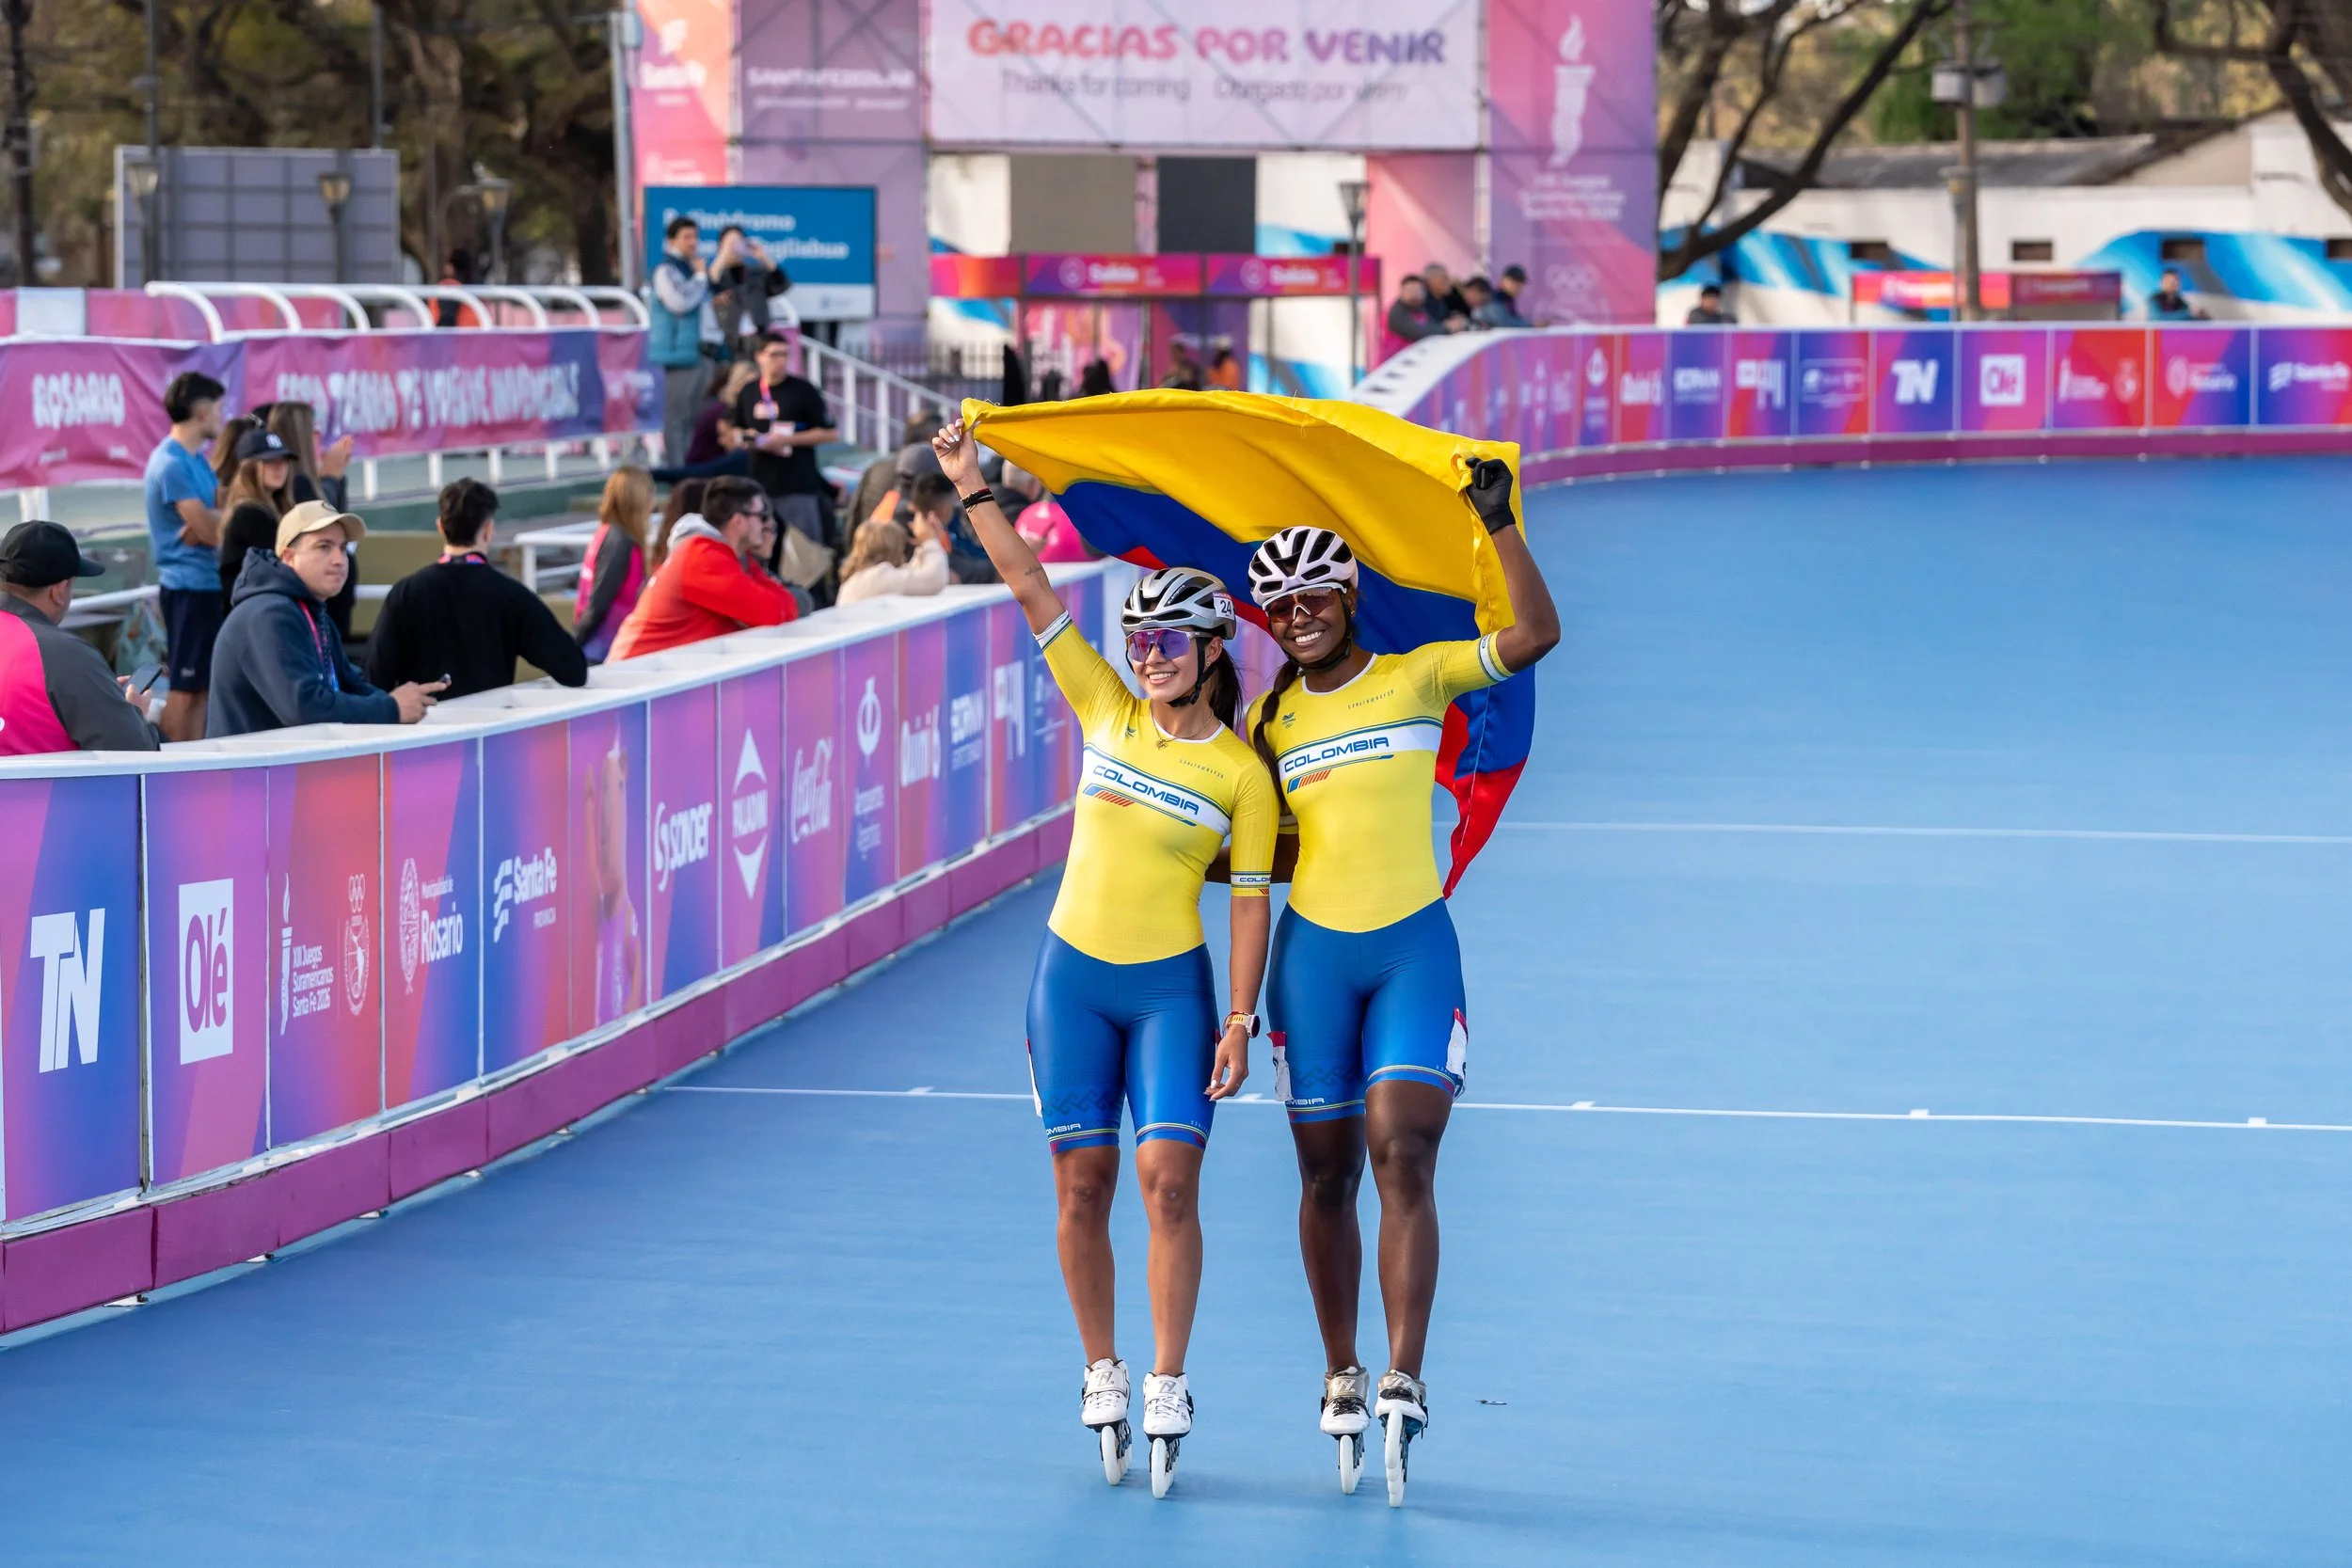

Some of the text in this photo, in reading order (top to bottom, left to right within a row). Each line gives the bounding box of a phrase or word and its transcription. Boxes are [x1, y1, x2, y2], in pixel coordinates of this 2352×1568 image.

[967, 18, 1445, 66] GRACIAS POR VENIR
[32, 372, 126, 431] ROSARIO
[1891, 358, 1939, 405] TN
[1220, 599, 1232, 615] 24
[1284, 736, 1390, 773] COLOMBIA
[1093, 765, 1200, 816] COLOMBIA
[514, 846, 558, 905] Santa Fe
[421, 900, 464, 964] Rosario
[30, 908, 105, 1073] TN
[186, 907, 229, 1033] Olé
[293, 995, 310, 1018] Santa
